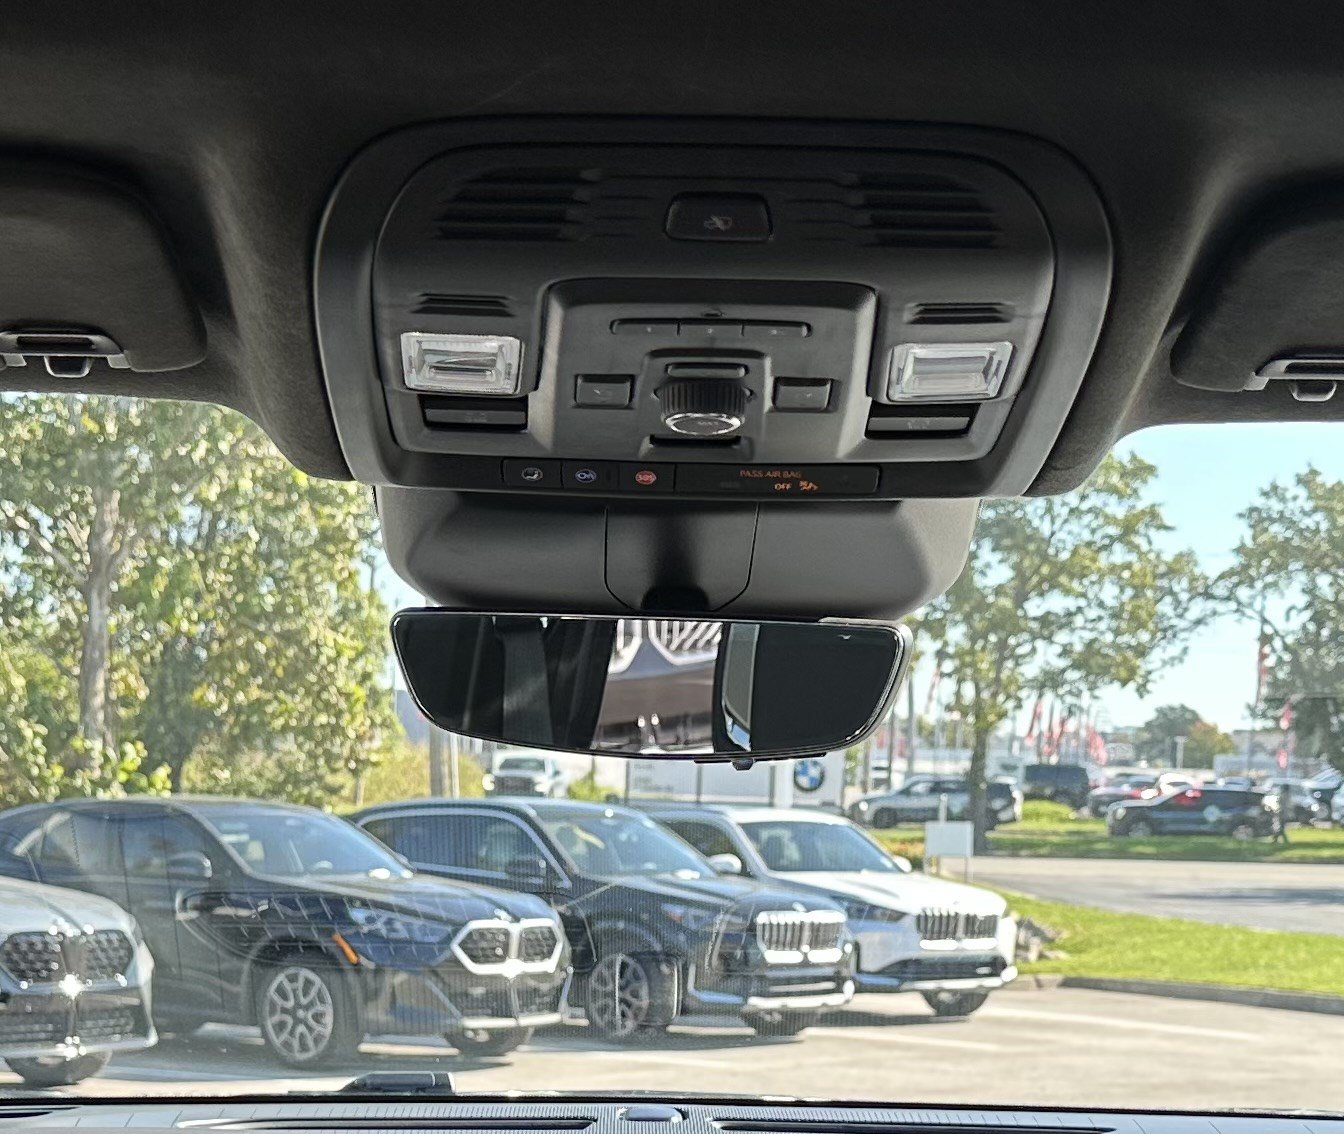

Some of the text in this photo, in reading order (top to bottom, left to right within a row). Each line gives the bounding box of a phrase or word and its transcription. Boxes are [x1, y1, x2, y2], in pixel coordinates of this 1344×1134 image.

[739, 470, 801, 479] PASS AIR BAG
